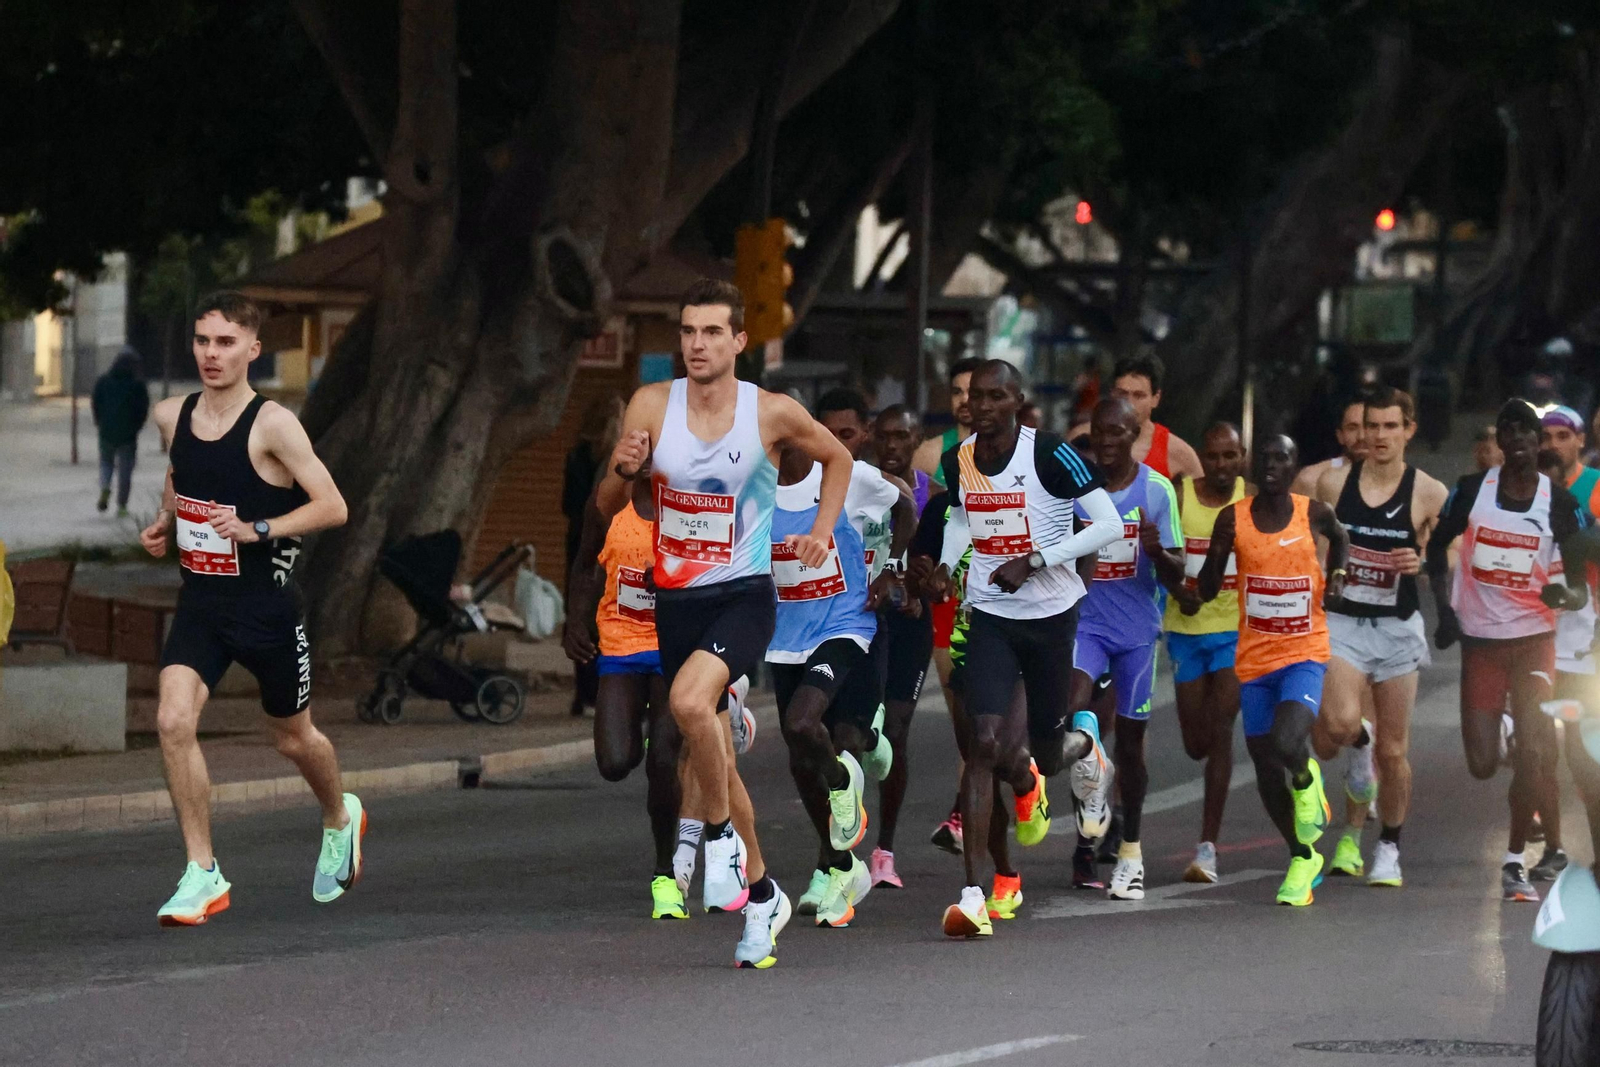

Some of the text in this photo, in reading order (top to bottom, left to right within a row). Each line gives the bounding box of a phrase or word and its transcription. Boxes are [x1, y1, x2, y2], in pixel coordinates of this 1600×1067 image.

[675, 494, 728, 508] GENERALI
[977, 495, 1020, 504] GENERALI
[185, 502, 210, 516] GENE
[679, 517, 709, 530] PACER
[189, 529, 208, 540] PACER
[1359, 526, 1408, 539] RUNNING
[707, 545, 720, 553] 42K
[1349, 565, 1385, 581] 14541
[1263, 580, 1306, 589] GENERALI
[295, 624, 311, 709] TEAM 247
